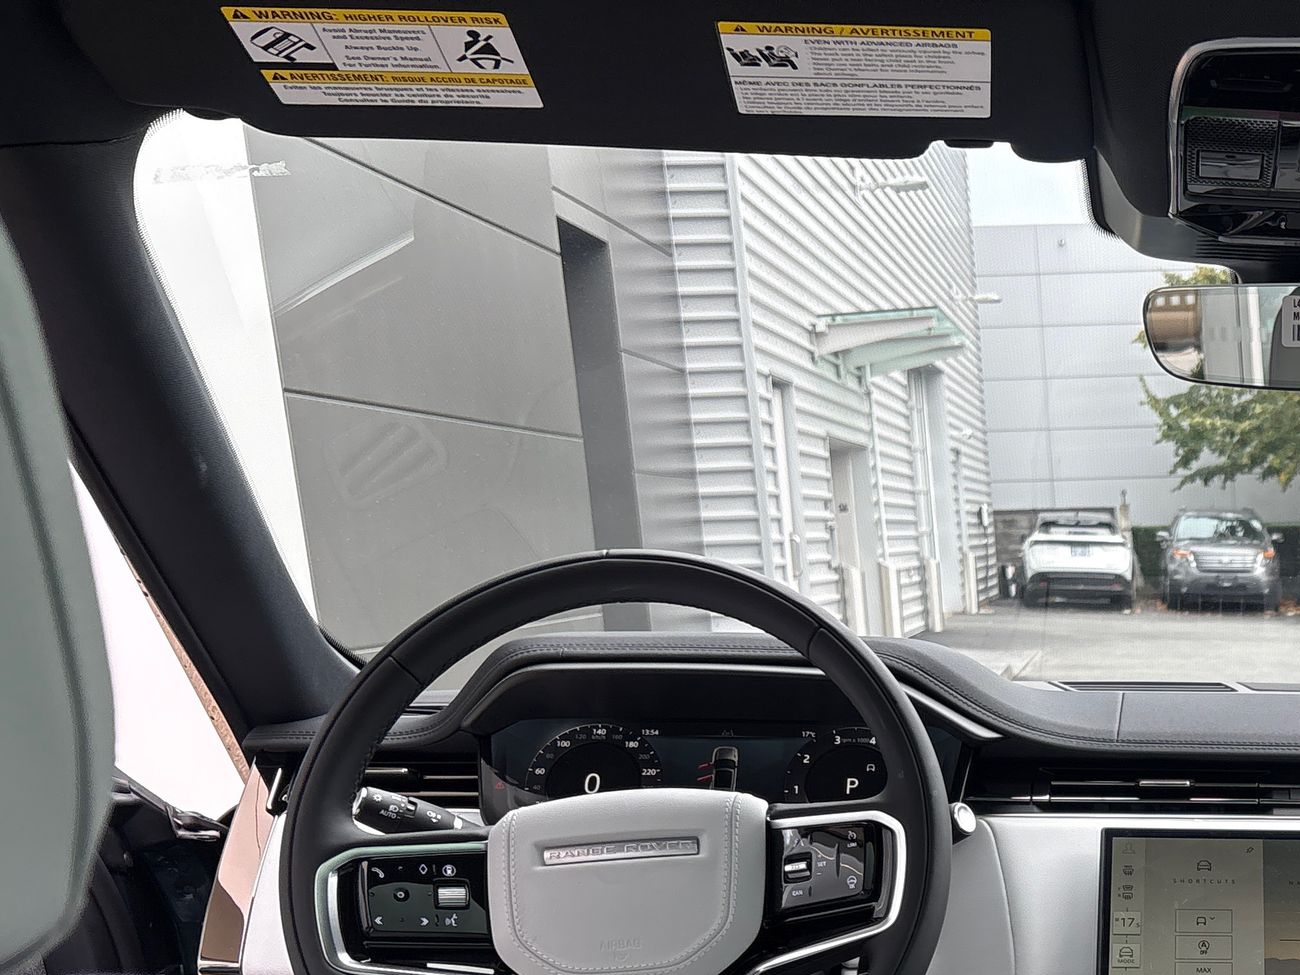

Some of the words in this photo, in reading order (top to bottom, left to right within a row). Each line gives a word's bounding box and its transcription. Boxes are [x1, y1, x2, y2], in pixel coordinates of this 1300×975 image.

[252, 9, 339, 21] WARNING:
[343, 13, 395, 22] HIGHER
[397, 14, 468, 24] ROLLOVER
[470, 16, 503, 25] RISK
[756, 25, 834, 35] WARNING
[849, 27, 975, 39] AVERTISSEMENT
[289, 72, 388, 82] AVERTISSEMENT:
[391, 75, 427, 83] RISQUE
[430, 76, 461, 84] ACCRU
[479, 77, 529, 86] CAPOTAGE
[834, 735, 841, 745] 3
[869, 736, 877, 745] 4
[803, 754, 810, 764] 2
[641, 768, 657, 776] 220
[584, 772, 601, 794] 0
[793, 785, 799, 794] 1
[846, 777, 859, 795] P
[379, 809, 397, 819] AUTO
[549, 845, 616, 860] RANGE
[624, 840, 698, 855] ROVER
[600, 937, 641, 950] AIRBAG
